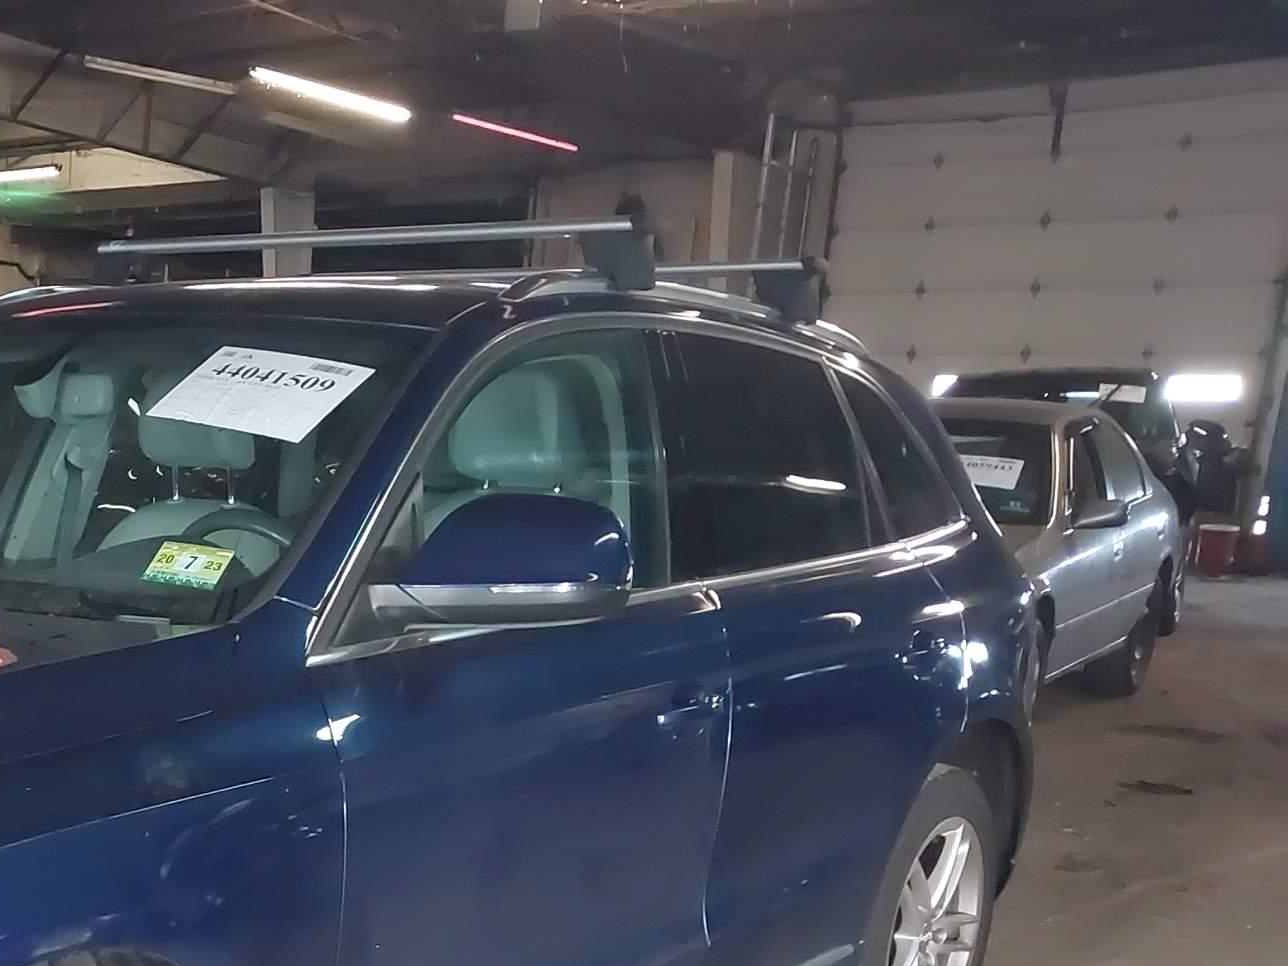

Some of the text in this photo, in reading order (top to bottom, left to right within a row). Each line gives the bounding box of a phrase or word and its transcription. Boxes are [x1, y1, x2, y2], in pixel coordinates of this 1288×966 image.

[212, 364, 336, 392] 44041509
[156, 553, 223, 571] 20 7 23
